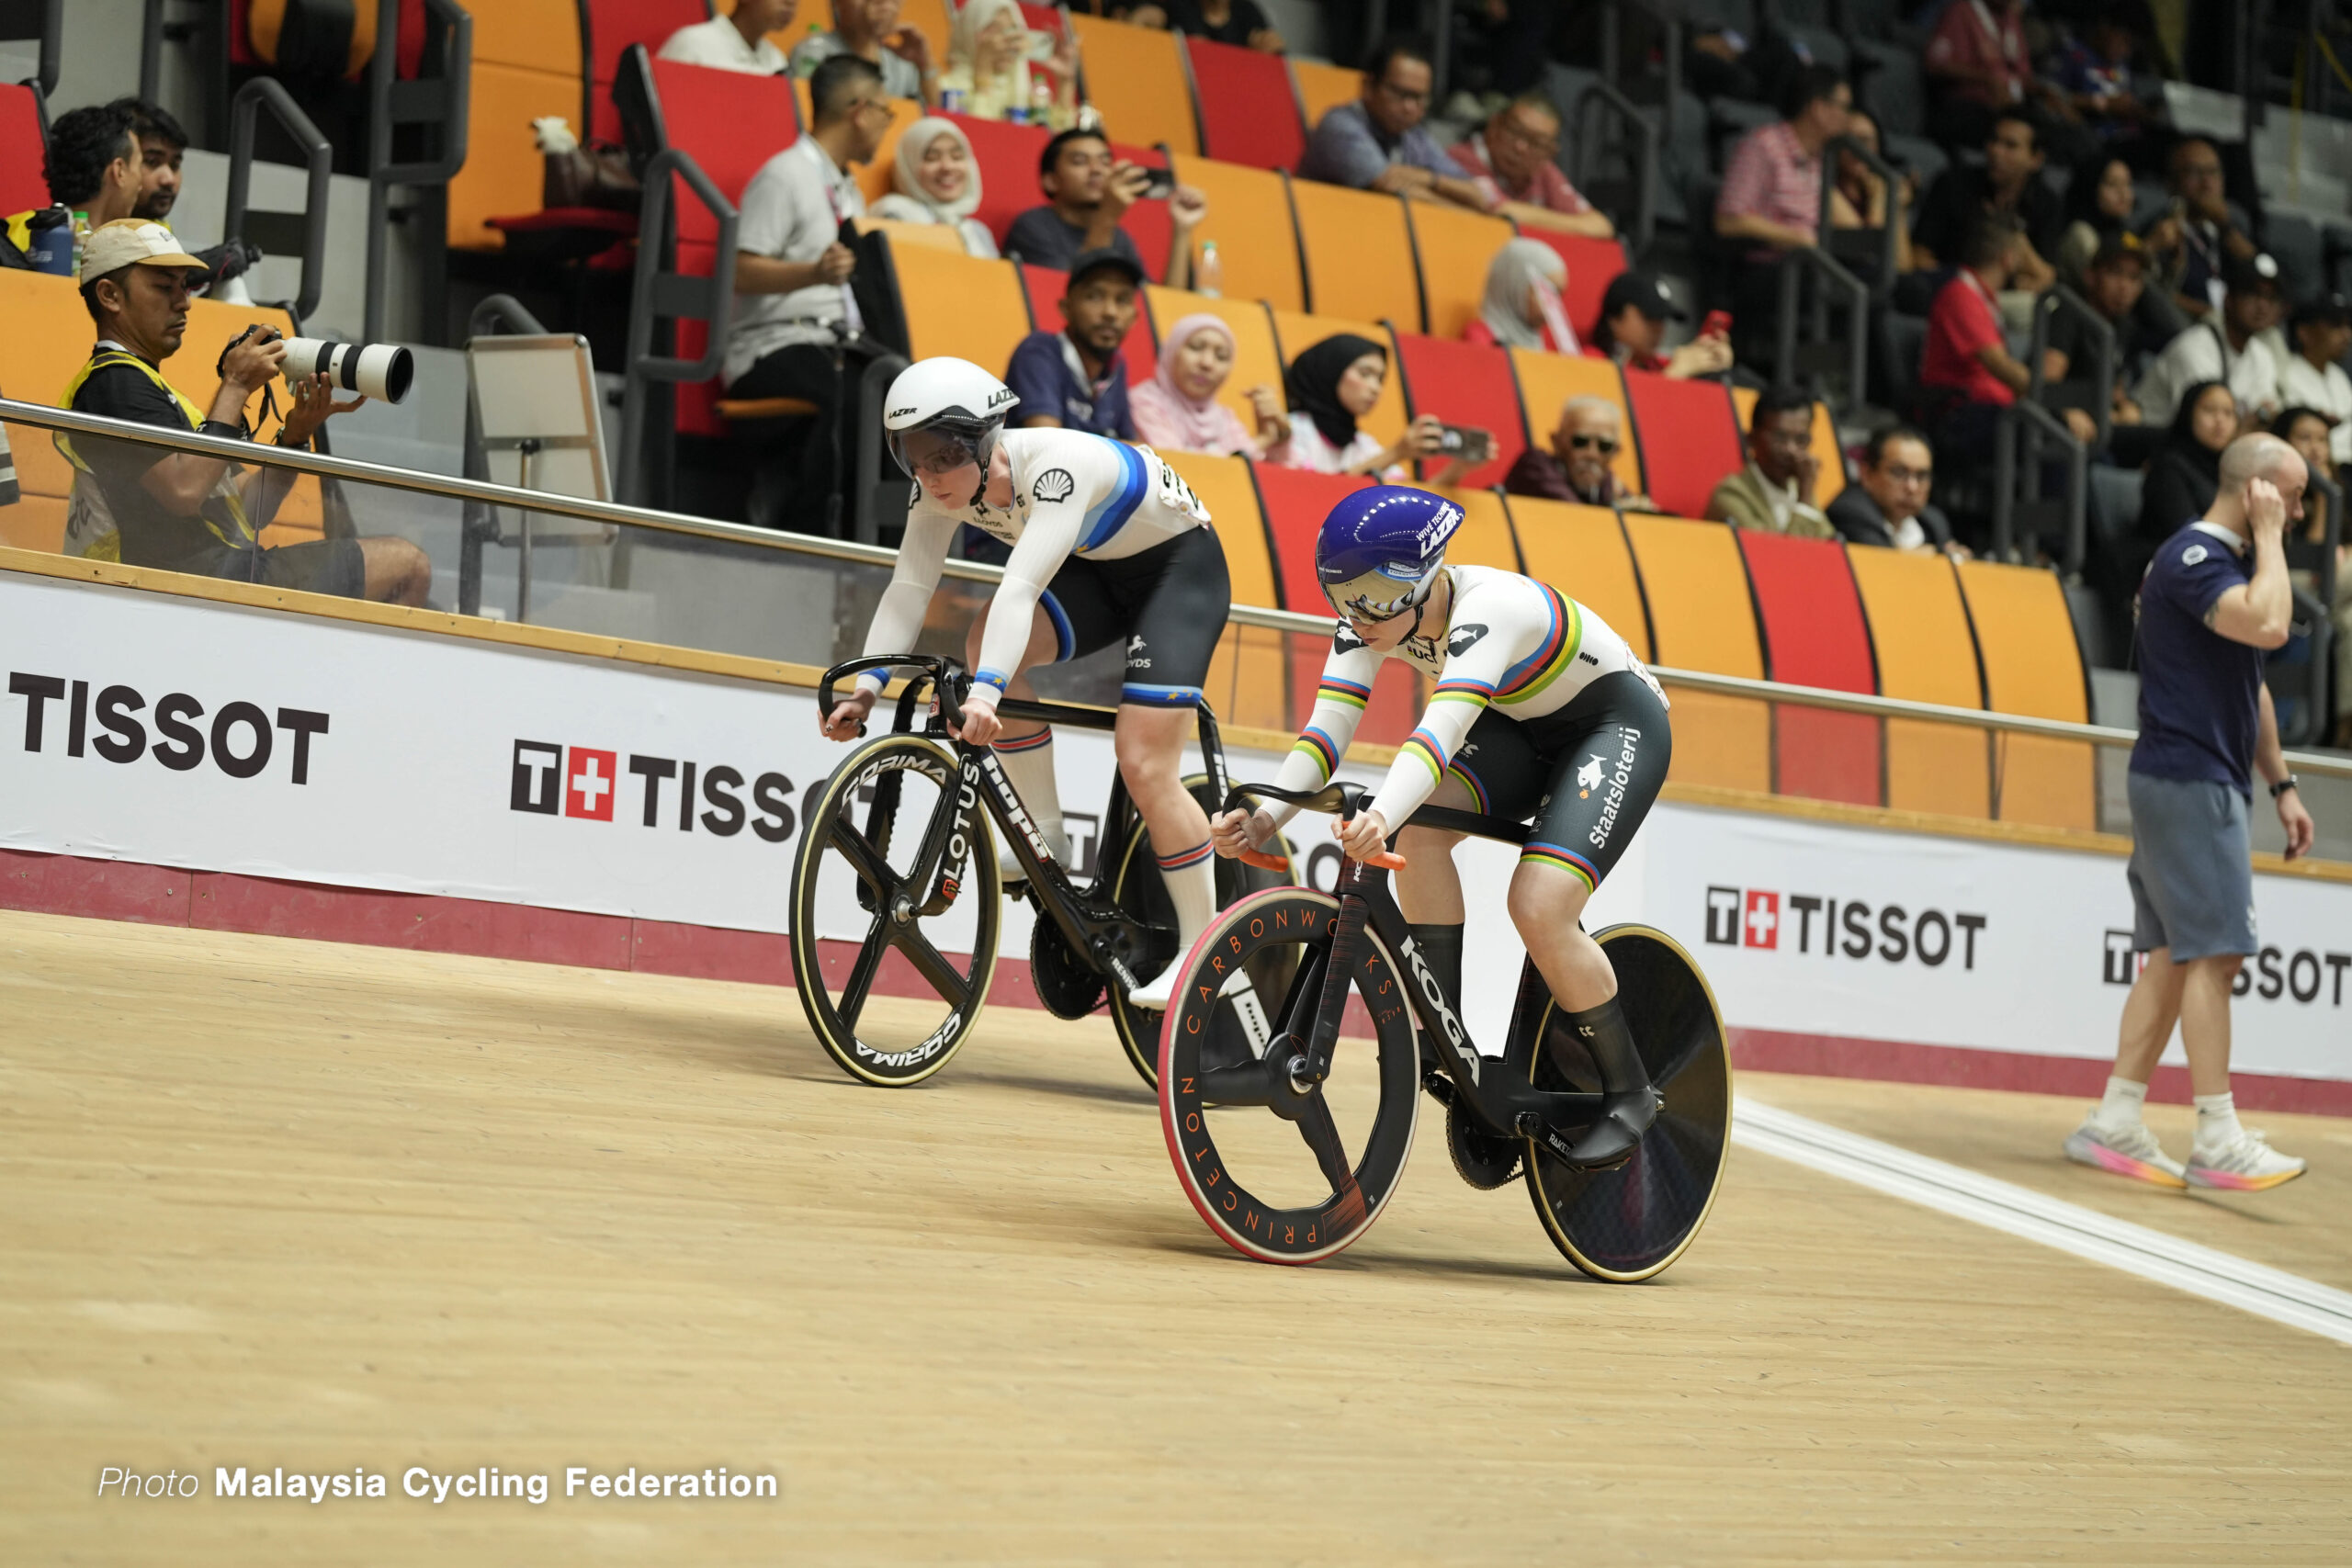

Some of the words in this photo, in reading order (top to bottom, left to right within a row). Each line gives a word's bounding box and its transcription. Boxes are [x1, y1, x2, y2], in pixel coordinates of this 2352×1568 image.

[888, 407, 918, 419] LAZER
[988, 388, 1017, 410] LAZE
[1420, 507, 1461, 559] LAZER
[1125, 658, 1152, 669] OYDS
[9, 671, 330, 785] TISSOT
[841, 755, 947, 808] CORIMA
[1589, 727, 1641, 850] Staatsloterij
[944, 762, 980, 881] LOTUS
[1789, 894, 1987, 972] TISSOT
[1112, 957, 1136, 991] RENIS
[1187, 908, 1392, 1033] CARBONWOKS
[855, 1012, 961, 1066] CORIMA
[1400, 934, 1479, 1088] KOGA
[1182, 1077, 1317, 1244] PRINCETON
